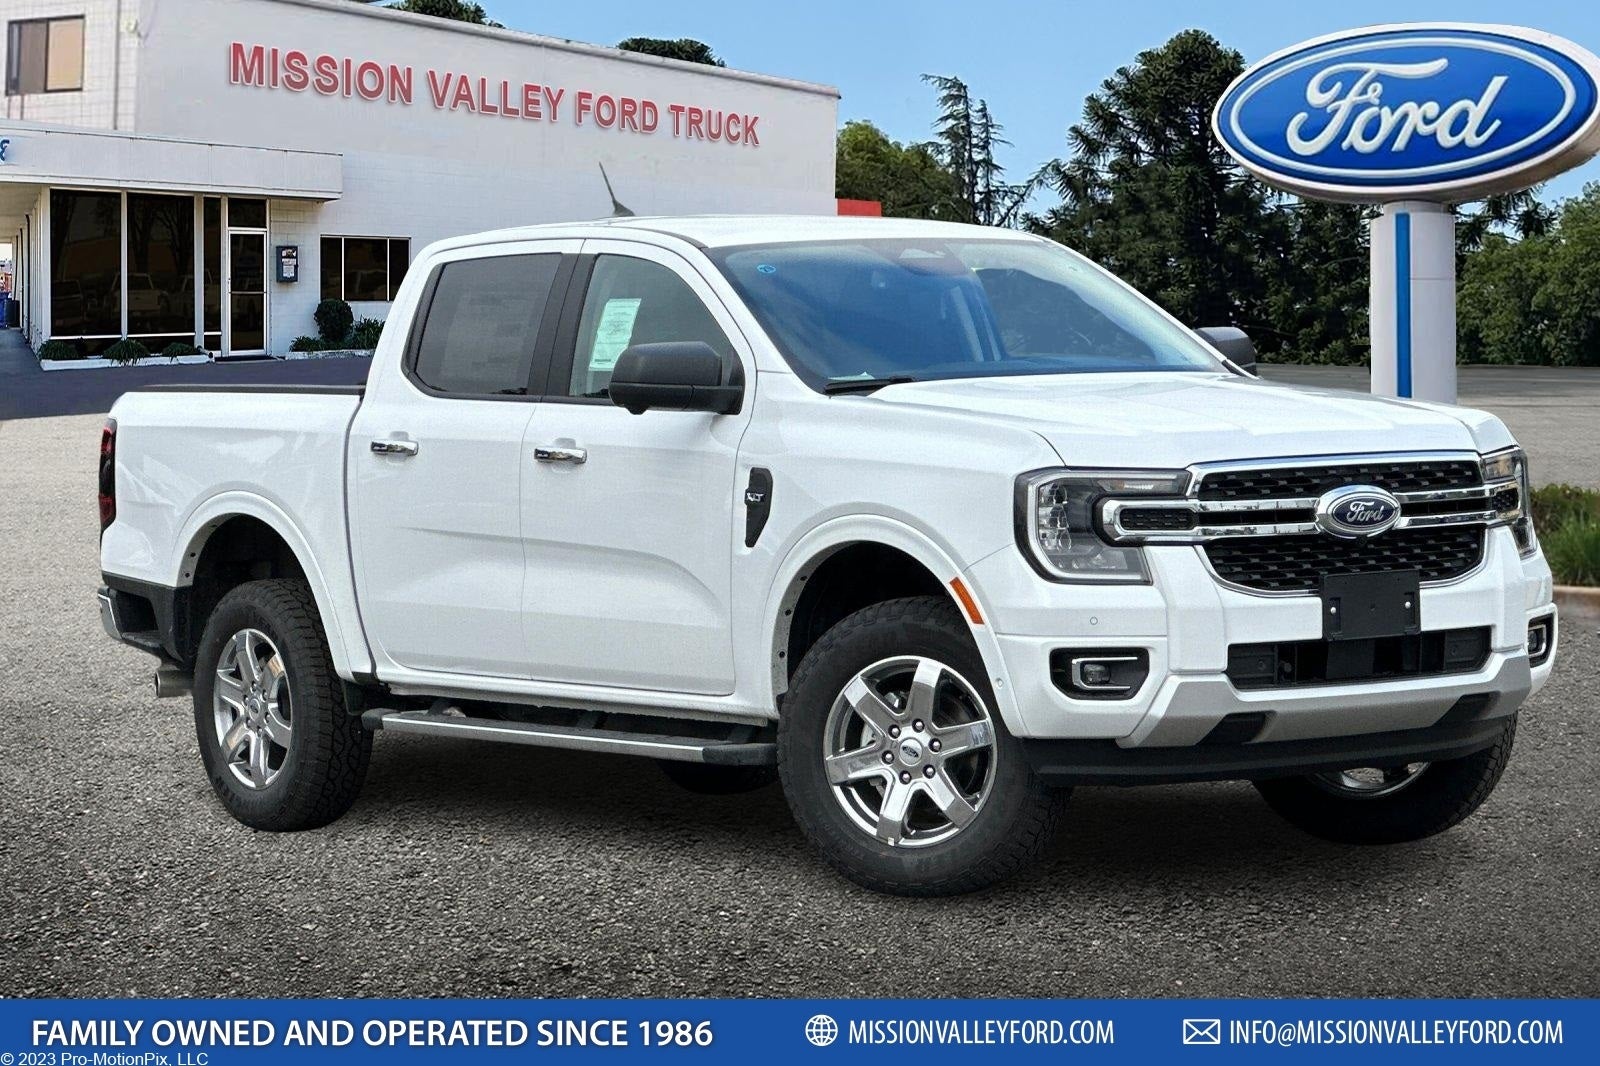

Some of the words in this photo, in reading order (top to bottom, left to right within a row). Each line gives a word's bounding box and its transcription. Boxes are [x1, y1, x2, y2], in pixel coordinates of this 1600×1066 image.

[229, 41, 413, 104] MISSION
[427, 69, 565, 122] VALLEY
[575, 90, 659, 134] FORD
[668, 103, 760, 146] TRUCK
[1286, 58, 1508, 156] Ford
[1346, 501, 1385, 522] Ford
